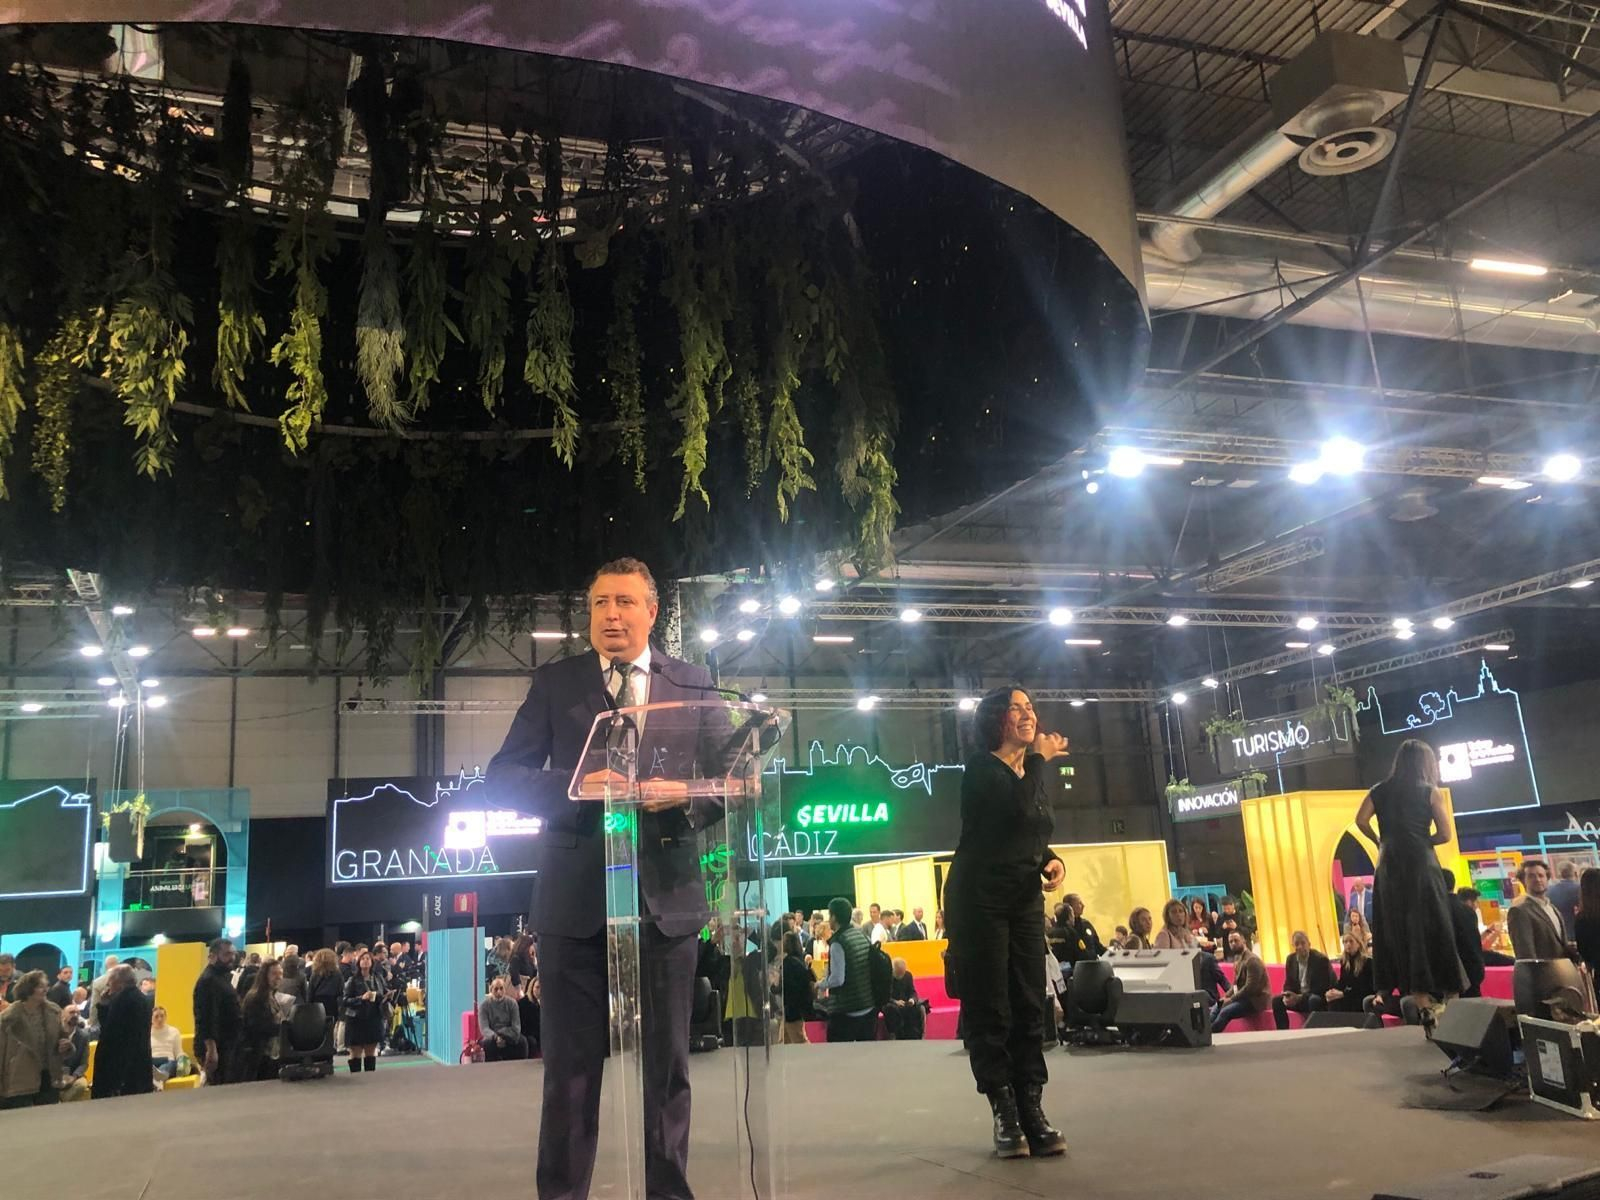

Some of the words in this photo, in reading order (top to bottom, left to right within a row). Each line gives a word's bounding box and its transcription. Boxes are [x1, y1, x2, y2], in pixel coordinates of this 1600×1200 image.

[1232, 724, 1310, 757] TURISMO
[1178, 787, 1238, 812] INNOVACIÓN
[751, 825, 839, 857] CÁDIZ
[336, 846, 498, 878] GRANADA
